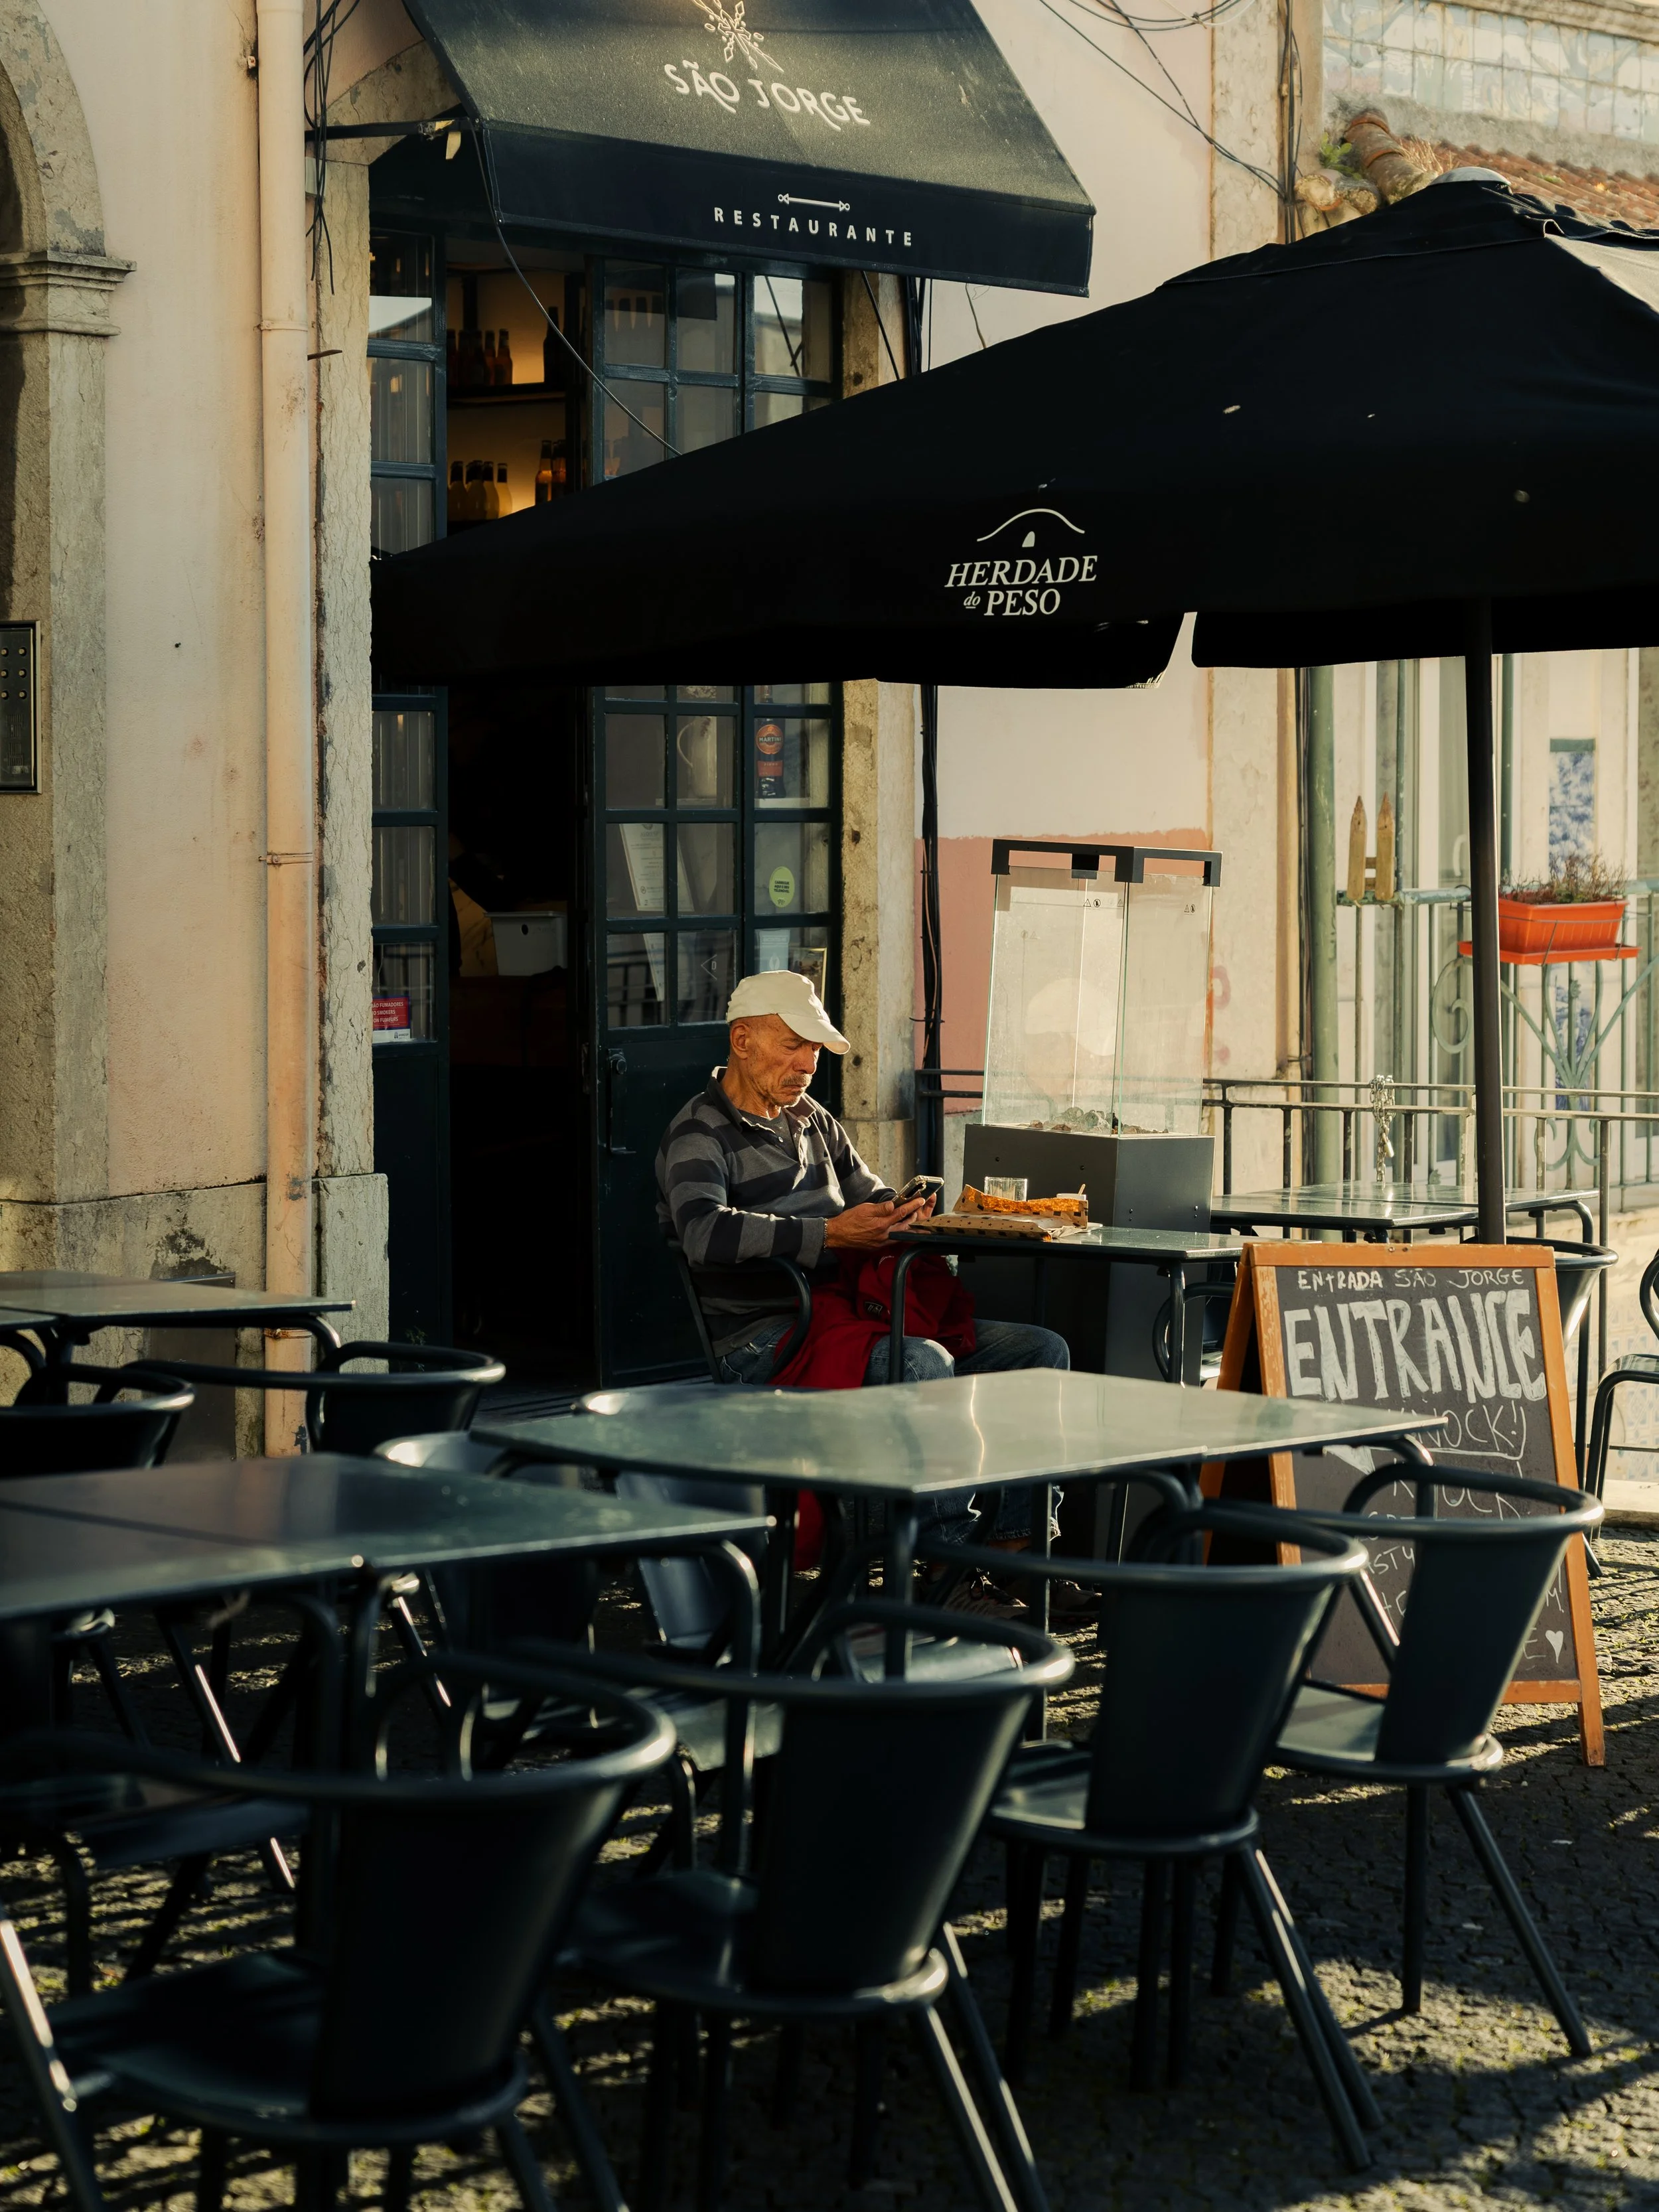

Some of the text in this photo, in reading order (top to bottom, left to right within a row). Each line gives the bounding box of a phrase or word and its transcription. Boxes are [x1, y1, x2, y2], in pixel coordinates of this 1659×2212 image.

[664, 60, 870, 130] SÃO JORGE
[714, 207, 912, 247] RESTAURANTE
[944, 555, 1098, 587] HERDADE
[964, 589, 1060, 616] do PESO
[1298, 1268, 1525, 1291] ENTRADA SÃO JORGE
[1284, 1289, 1547, 1403] ENTRANCE
